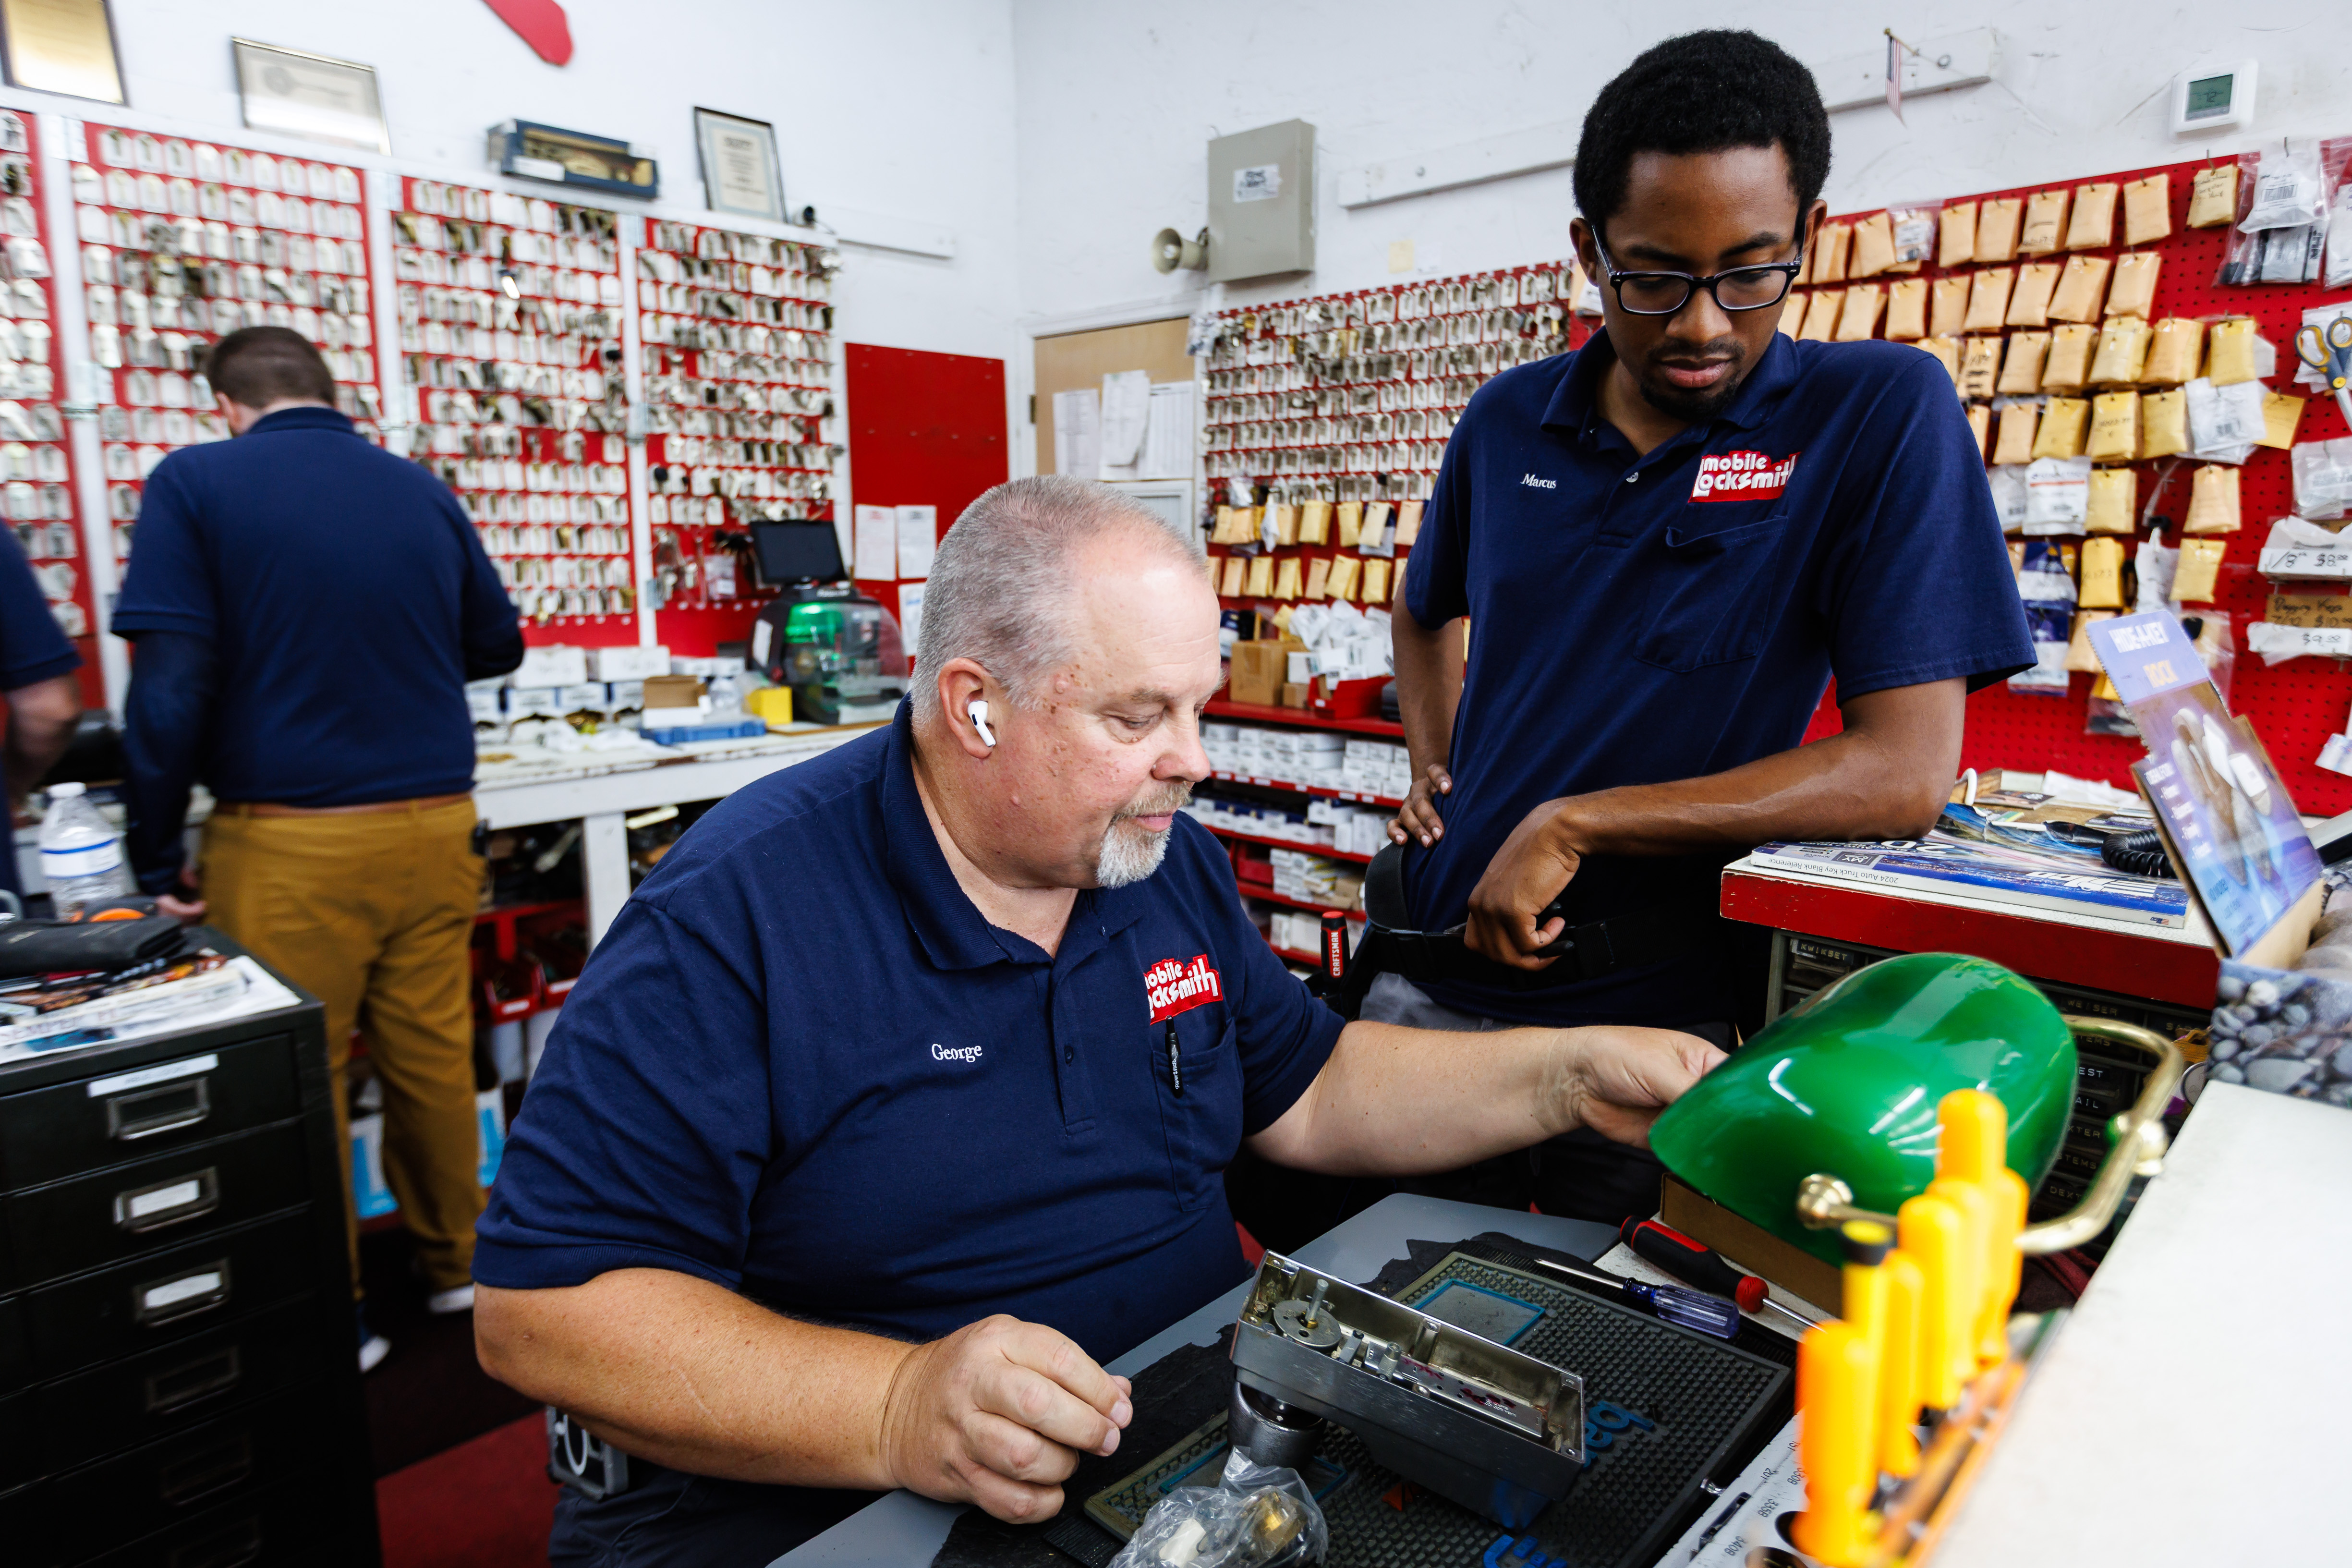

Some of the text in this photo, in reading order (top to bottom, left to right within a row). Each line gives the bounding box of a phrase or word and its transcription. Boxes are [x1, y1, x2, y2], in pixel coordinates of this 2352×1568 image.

[1703, 453, 1767, 472] mobile
[1520, 473, 1556, 489] Marcus
[1842, 854, 1864, 863] MY
[1768, 858, 1899, 884] 2024 Auto Truck Key Blank Reference
[1331, 931, 1341, 976] CRAFTSMAN
[1801, 943, 1848, 960] KWIKSET
[1148, 958, 1219, 1019] cksmith
[2068, 999, 2118, 1016] WEISER
[932, 1044, 982, 1063] George
[2078, 1067, 2104, 1078] EST
[2074, 1096, 2099, 1109] AIL
[2068, 1125, 2101, 1139] XTER
[1760, 1467, 1774, 1480] 201
[1758, 1498, 1779, 1518] 335B
